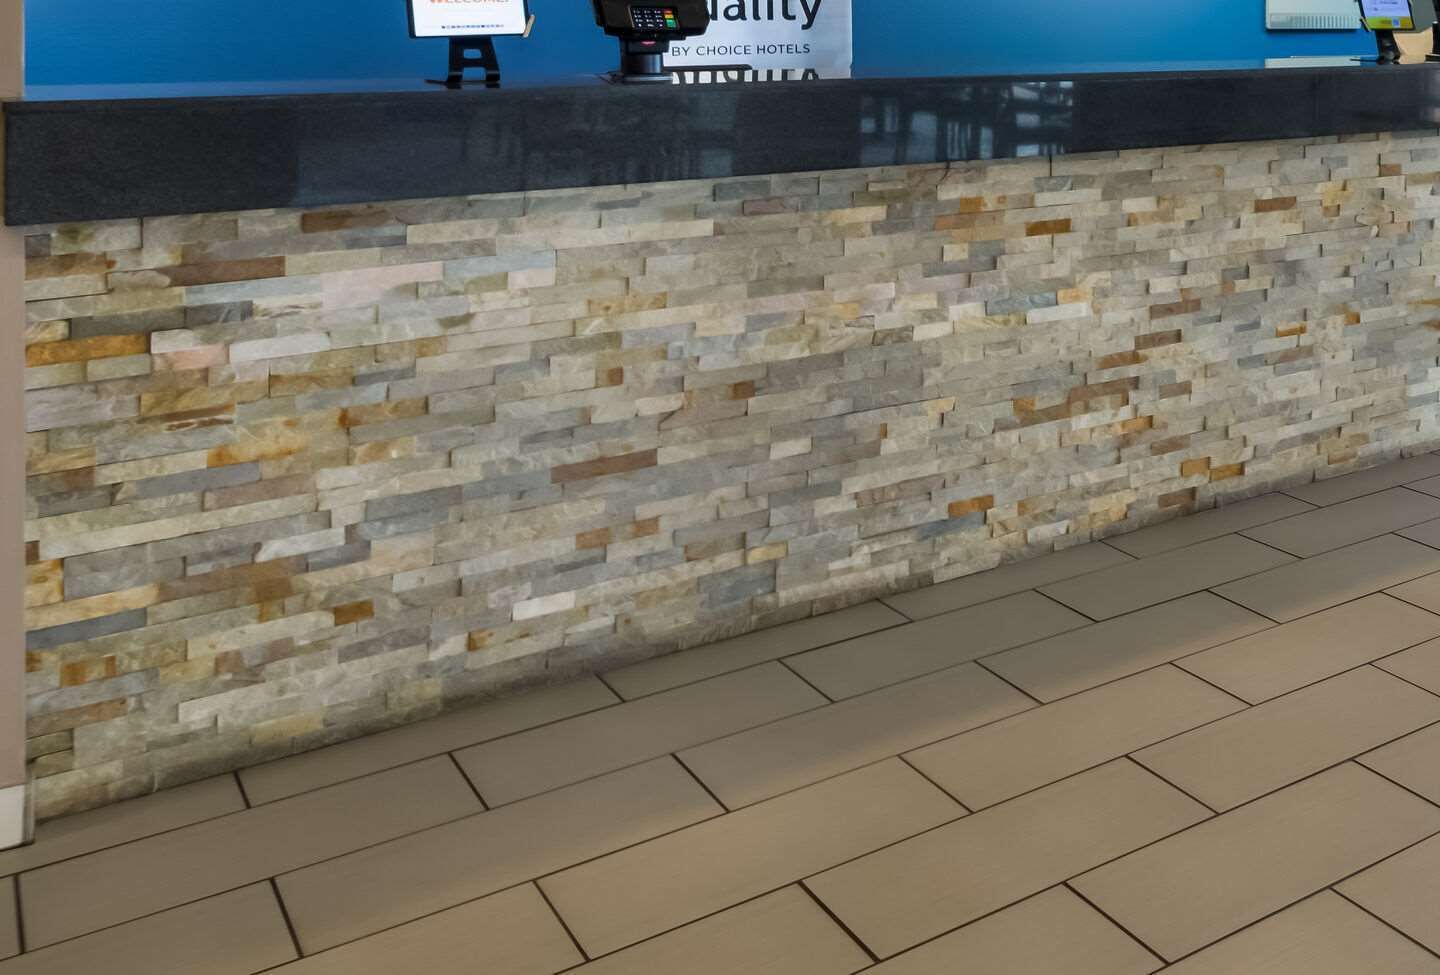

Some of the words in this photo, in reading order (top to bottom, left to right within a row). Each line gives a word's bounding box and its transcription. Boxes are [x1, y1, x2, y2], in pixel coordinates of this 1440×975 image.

[671, 45, 691, 57] BY
[695, 44, 752, 56] CHOICE
[756, 43, 811, 55] HOTELS
